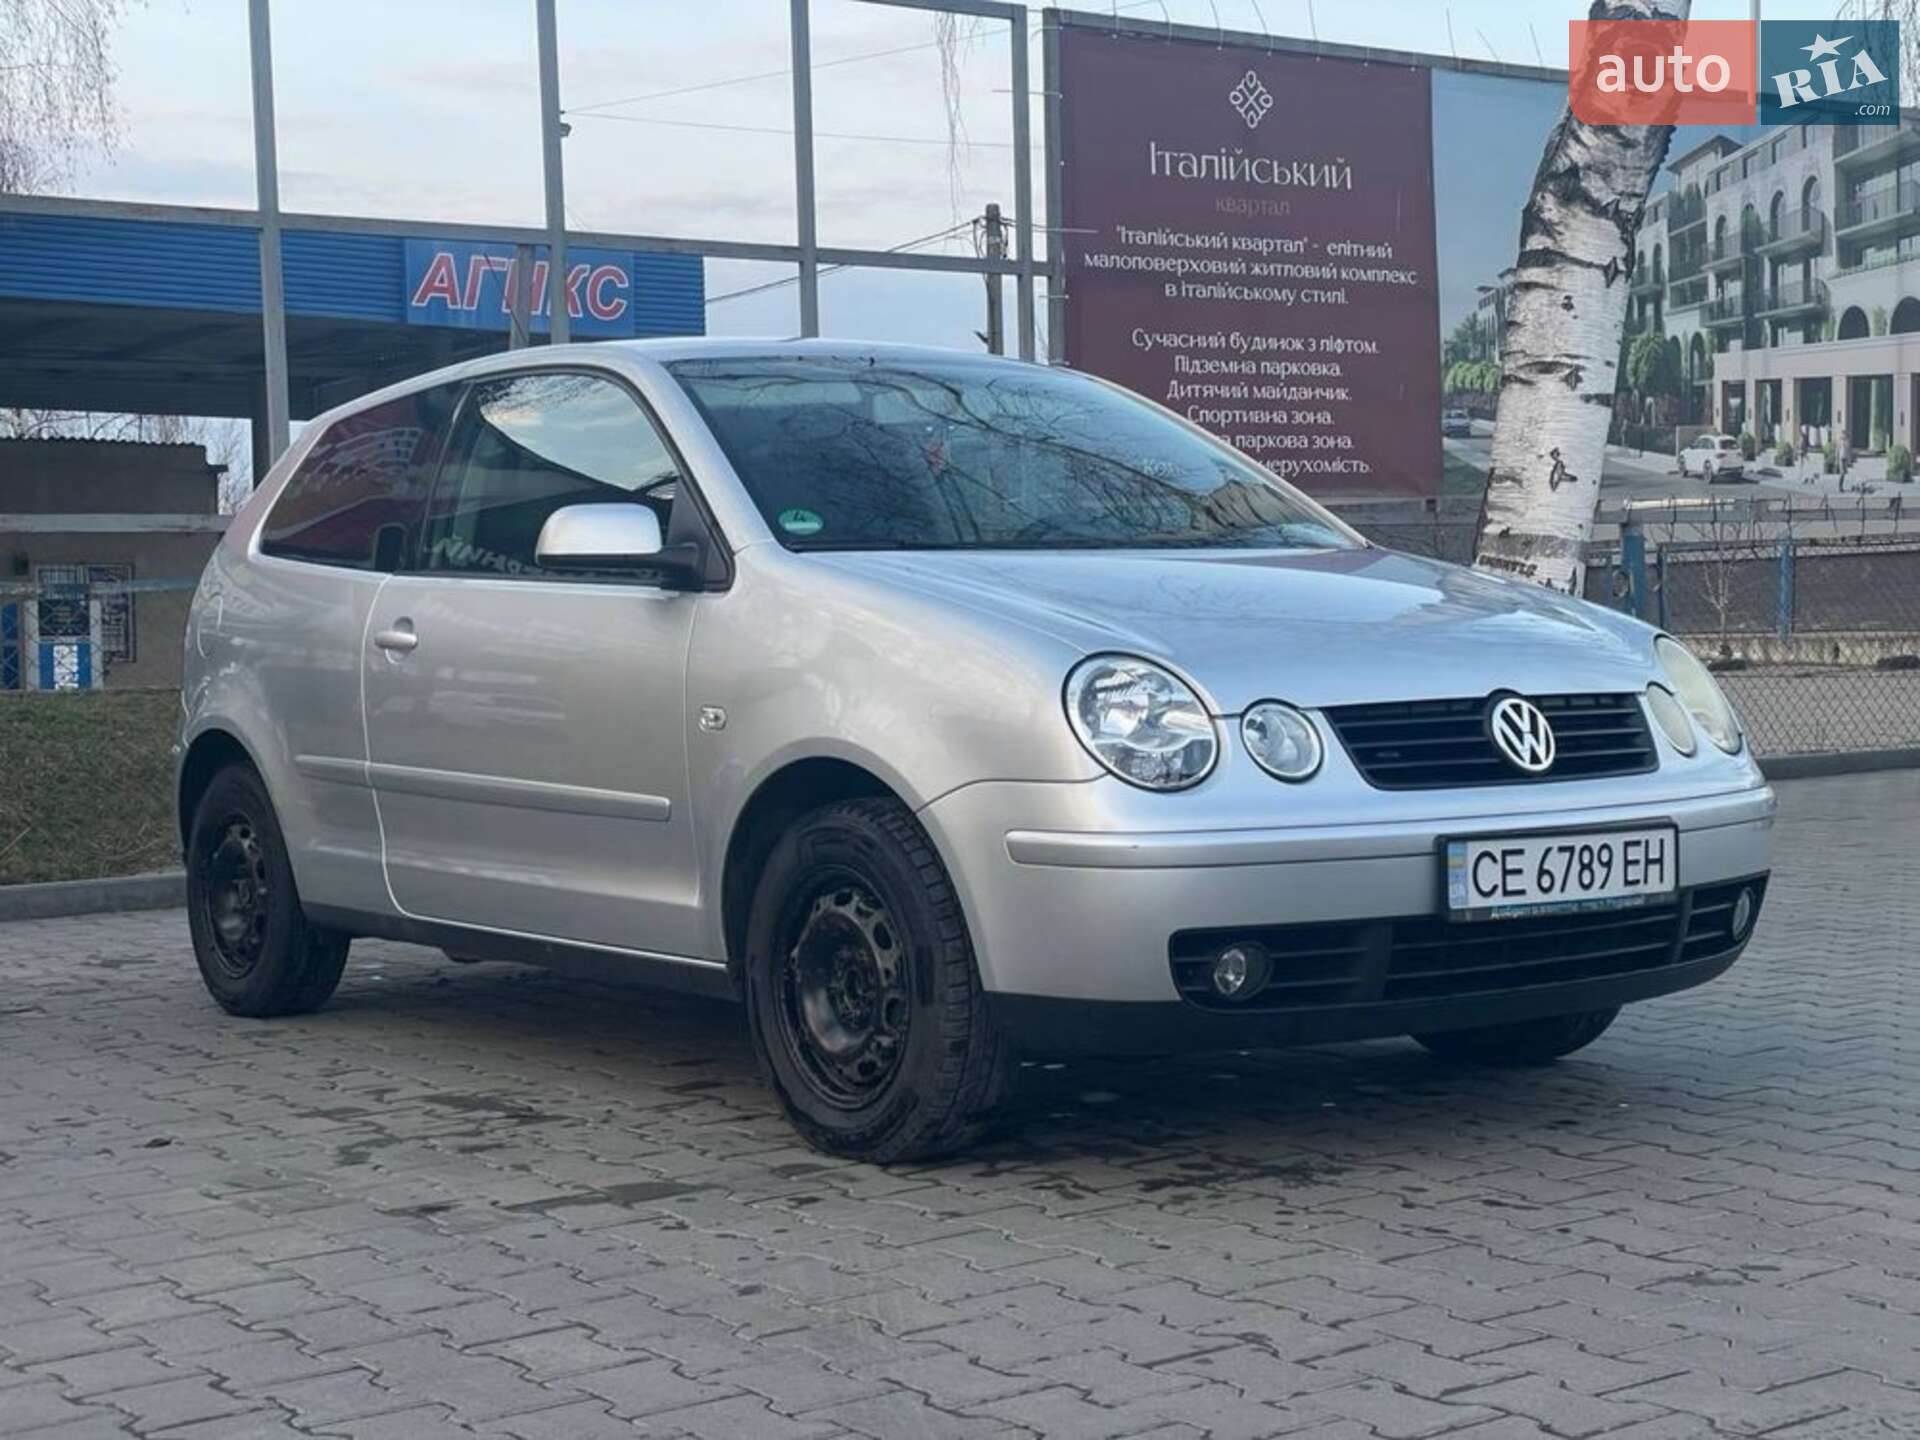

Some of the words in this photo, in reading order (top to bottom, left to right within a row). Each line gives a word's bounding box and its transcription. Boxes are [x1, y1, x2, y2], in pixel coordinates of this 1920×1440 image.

[1150, 141, 1352, 190] Італійський
[1215, 198, 1291, 219] квартал
[1327, 240, 1393, 259] елітний
[1084, 253, 1246, 277] малоповерховий
[1250, 262, 1337, 280] житловий
[1340, 268, 1418, 285] комплекс
[1165, 283, 1177, 297] в
[1301, 287, 1349, 305] стилі.
[1132, 327, 1226, 352] Сучасний
[1230, 331, 1304, 354] будинок
[1307, 337, 1317, 352] з
[1319, 335, 1380, 354] ліфтом.
[1174, 354, 1257, 375] Підземна
[1166, 379, 1249, 400] Дитячий
[1252, 382, 1352, 402] майданчик.
[1187, 405, 1287, 428] Спортивна
[1291, 410, 1335, 425] зона.
[1235, 434, 1309, 453] паркова
[1312, 435, 1355, 449] зона.
[1472, 849, 1527, 898] CE
[1537, 842, 1614, 894] 6789
[1623, 837, 1665, 887] EH
